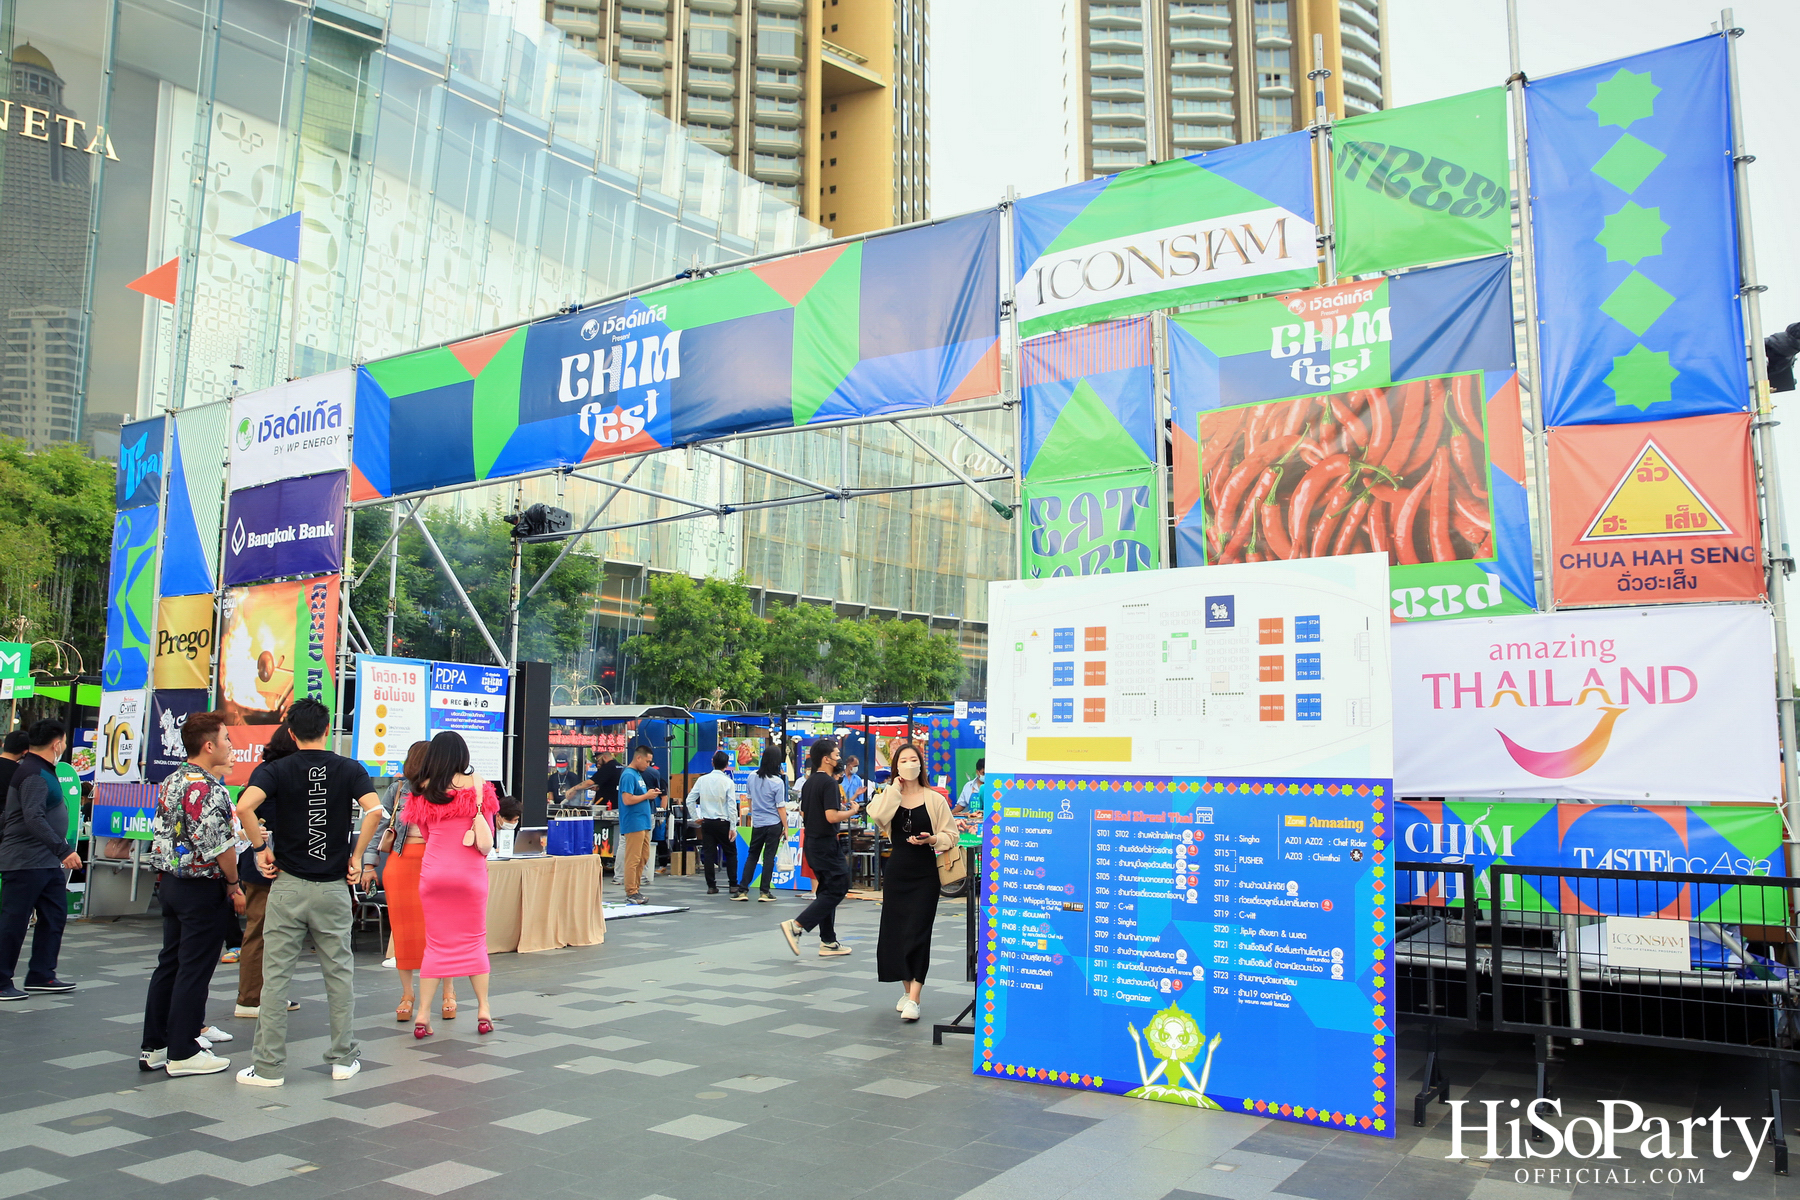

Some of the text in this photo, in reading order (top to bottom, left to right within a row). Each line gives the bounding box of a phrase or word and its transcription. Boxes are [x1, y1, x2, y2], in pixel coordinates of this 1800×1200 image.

[1337, 141, 1507, 220] STREET
[1035, 217, 1292, 306] ICONSIAM
[612, 332, 631, 343] Present
[1289, 348, 1373, 386] fest
[578, 389, 659, 443] fest
[274, 434, 340, 456] BY WP ENERGY
[1028, 485, 1150, 557] EAT
[247, 520, 335, 549] Bangkok Bank
[1560, 550, 1627, 570] CHUA
[1632, 548, 1684, 567] HAH
[1391, 572, 1503, 618] eed
[157, 627, 210, 660] Prego
[1489, 633, 1617, 663] amazing
[435, 668, 467, 685] PDPA
[1421, 665, 1699, 710] THAILAND
[1023, 808, 1054, 822] Dining
[1097, 811, 1111, 819] Zone
[124, 817, 146, 833] LINE
[1287, 817, 1364, 833] Zone Amazing
[1096, 829, 1110, 837] ST01
[1115, 830, 1129, 838] ST02
[1239, 835, 1260, 845] Singha
[1333, 838, 1348, 847] Chef
[1404, 822, 1514, 857] CHIM
[1214, 849, 1229, 857] ST15
[1312, 853, 1340, 862] Chimthai
[1096, 858, 1110, 866] ST04
[1239, 856, 1263, 864] PUSHER
[1711, 851, 1772, 877] Asia
[1214, 864, 1229, 872] ST16
[1214, 879, 1229, 887] ST17
[1214, 894, 1229, 902] ST18
[1095, 901, 1109, 909] ST07
[1214, 909, 1256, 919] ST19 C-vitt
[1118, 918, 1137, 927] Singha
[1094, 930, 1109, 938] ST09
[1214, 925, 1229, 933] ST20
[1239, 927, 1256, 937] JipJip
[1281, 930, 1287, 938] &
[1022, 938, 1036, 948] Prego
[1213, 940, 1228, 948] ST21
[1612, 933, 1685, 948] ICONSIAM
[1094, 945, 1108, 953] ST10
[1213, 956, 1229, 964] ST22
[1094, 974, 1108, 982] ST12
[1213, 971, 1228, 979] ST23
[1213, 986, 1229, 994] ST24
[1093, 989, 1152, 1002] ST13 Organizer
